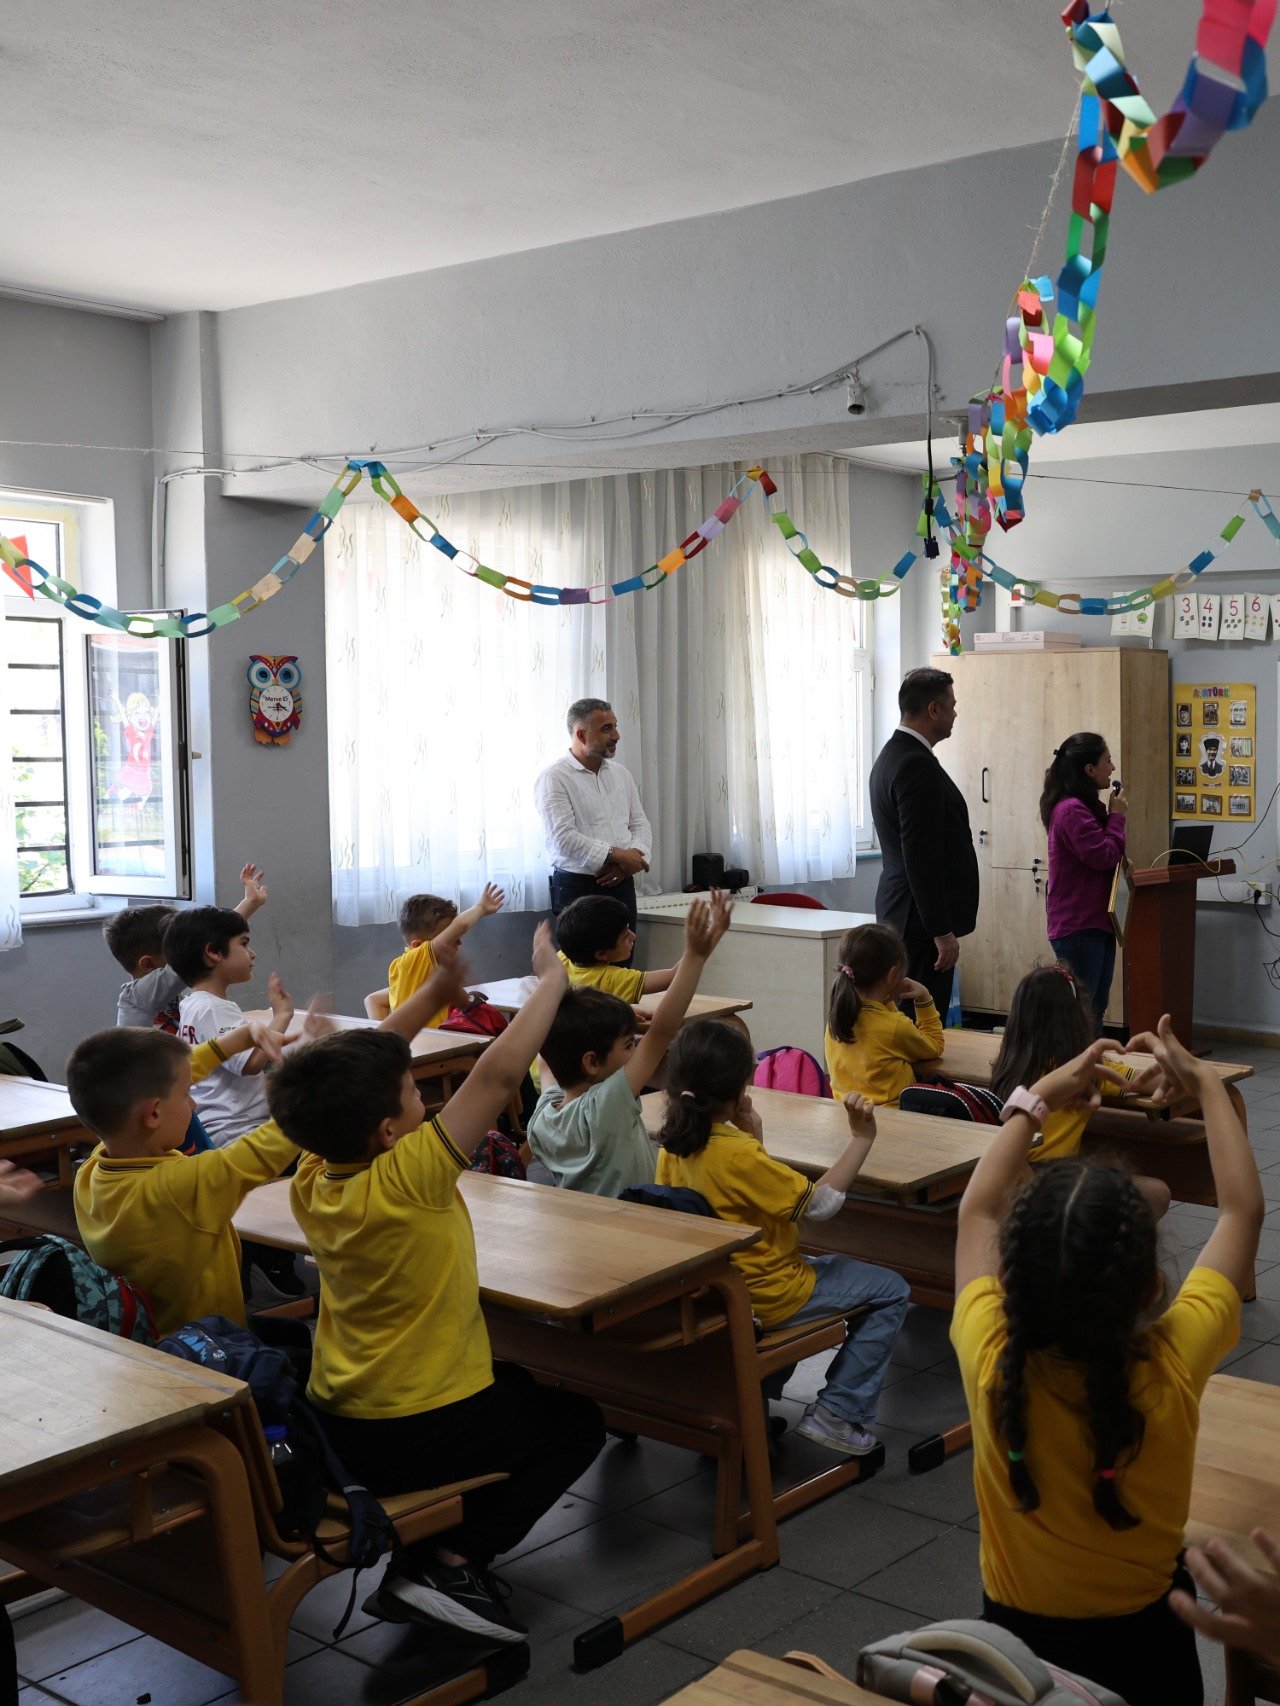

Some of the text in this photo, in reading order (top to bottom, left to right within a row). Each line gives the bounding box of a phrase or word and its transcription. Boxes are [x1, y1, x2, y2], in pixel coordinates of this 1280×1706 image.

[1182, 597, 1191, 613] 3
[1203, 598, 1213, 613] 4
[1230, 600, 1238, 616] 5
[1252, 596, 1261, 612] 6
